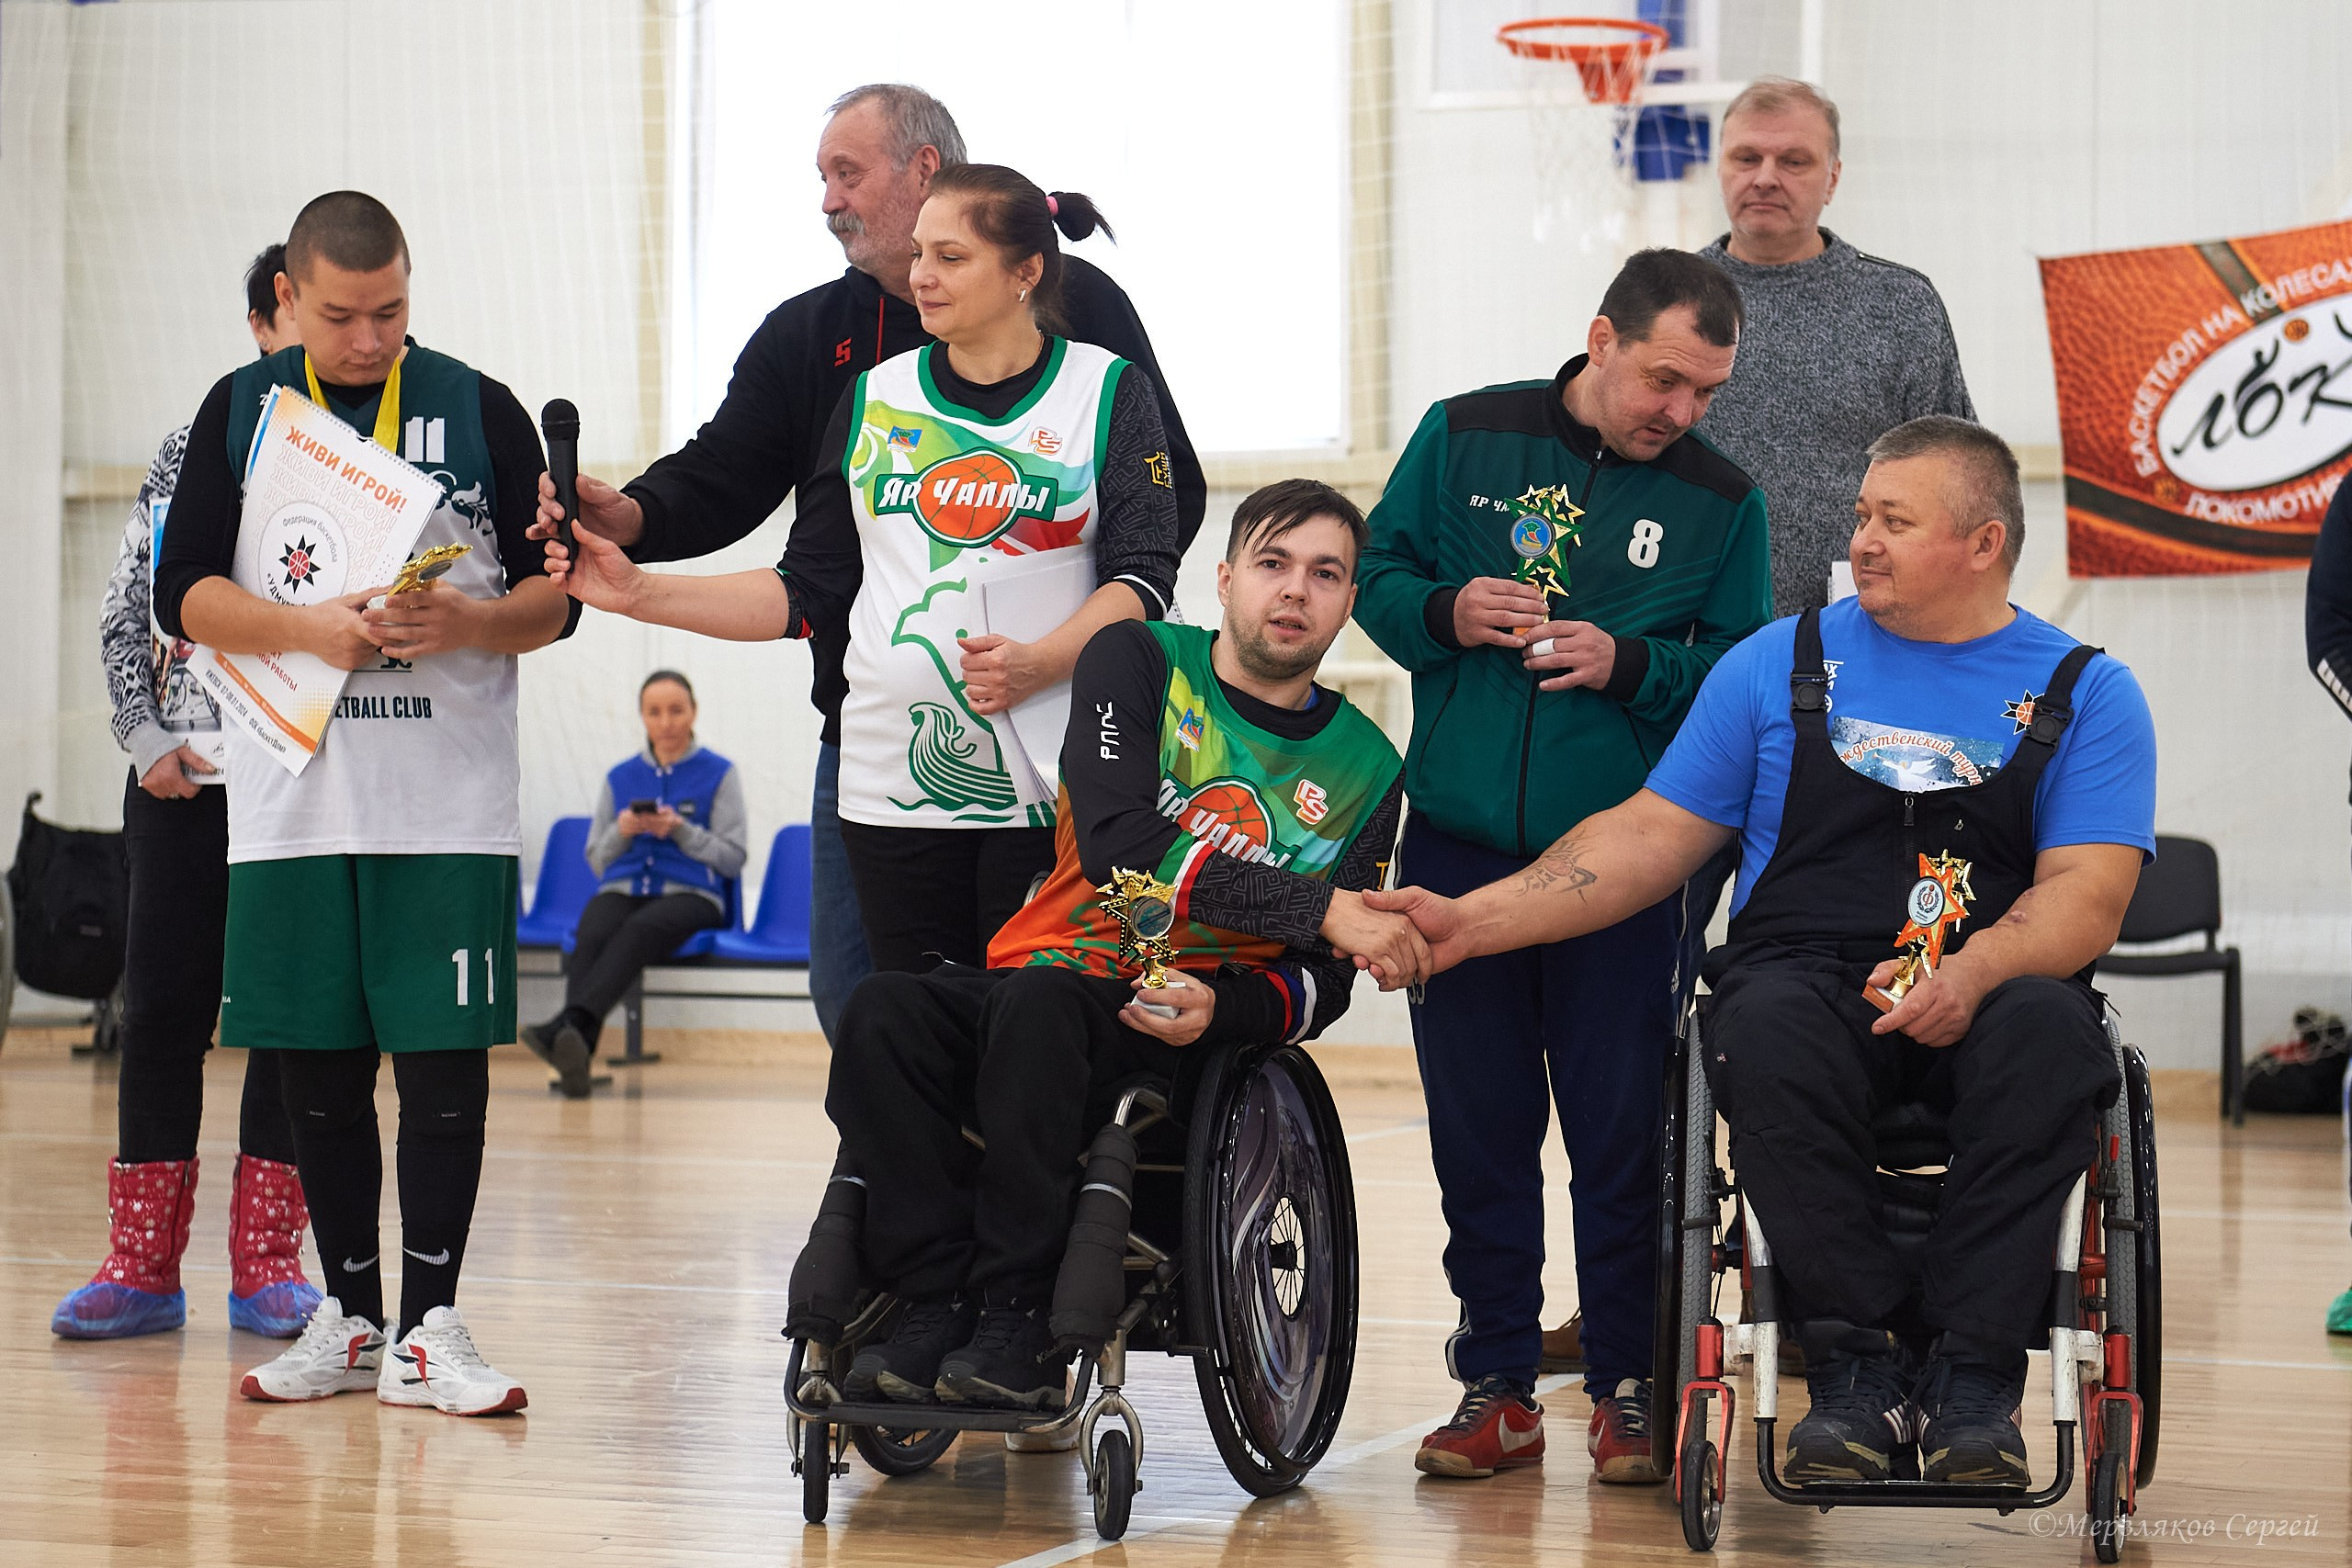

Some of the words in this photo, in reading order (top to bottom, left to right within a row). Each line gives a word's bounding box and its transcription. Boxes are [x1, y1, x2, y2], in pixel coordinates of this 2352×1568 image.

[2128, 328, 2206, 478] БАСКЕТБОЛ
[2200, 304, 2246, 340] НА
[405, 416, 445, 464] 11
[277, 443, 330, 491] ЖИВИ
[330, 479, 397, 533] ИГРОЙ!
[286, 425, 341, 471] ЖИВИ
[340, 461, 407, 513] ИГРОЙ!
[878, 478, 922, 508] ЯР
[933, 478, 1051, 512] ЧАЛЛЫ
[1469, 495, 1489, 508] ЯР
[1494, 500, 1510, 513] ЧА
[2184, 473, 2343, 525] ЛОКОМОТИ
[283, 514, 317, 527] Федерация
[316, 520, 338, 563] баскетбола
[1627, 518, 1663, 569] 8
[205, 669, 221, 689] ИЖЕВСК
[270, 661, 298, 691] РАБОТЫ
[335, 695, 390, 718] ETBALL
[392, 695, 433, 719] CLUB
[1838, 730, 1954, 764] ождественский
[1950, 751, 1984, 785] турн
[1294, 779, 1329, 825] PS
[452, 949, 493, 1005] 11
